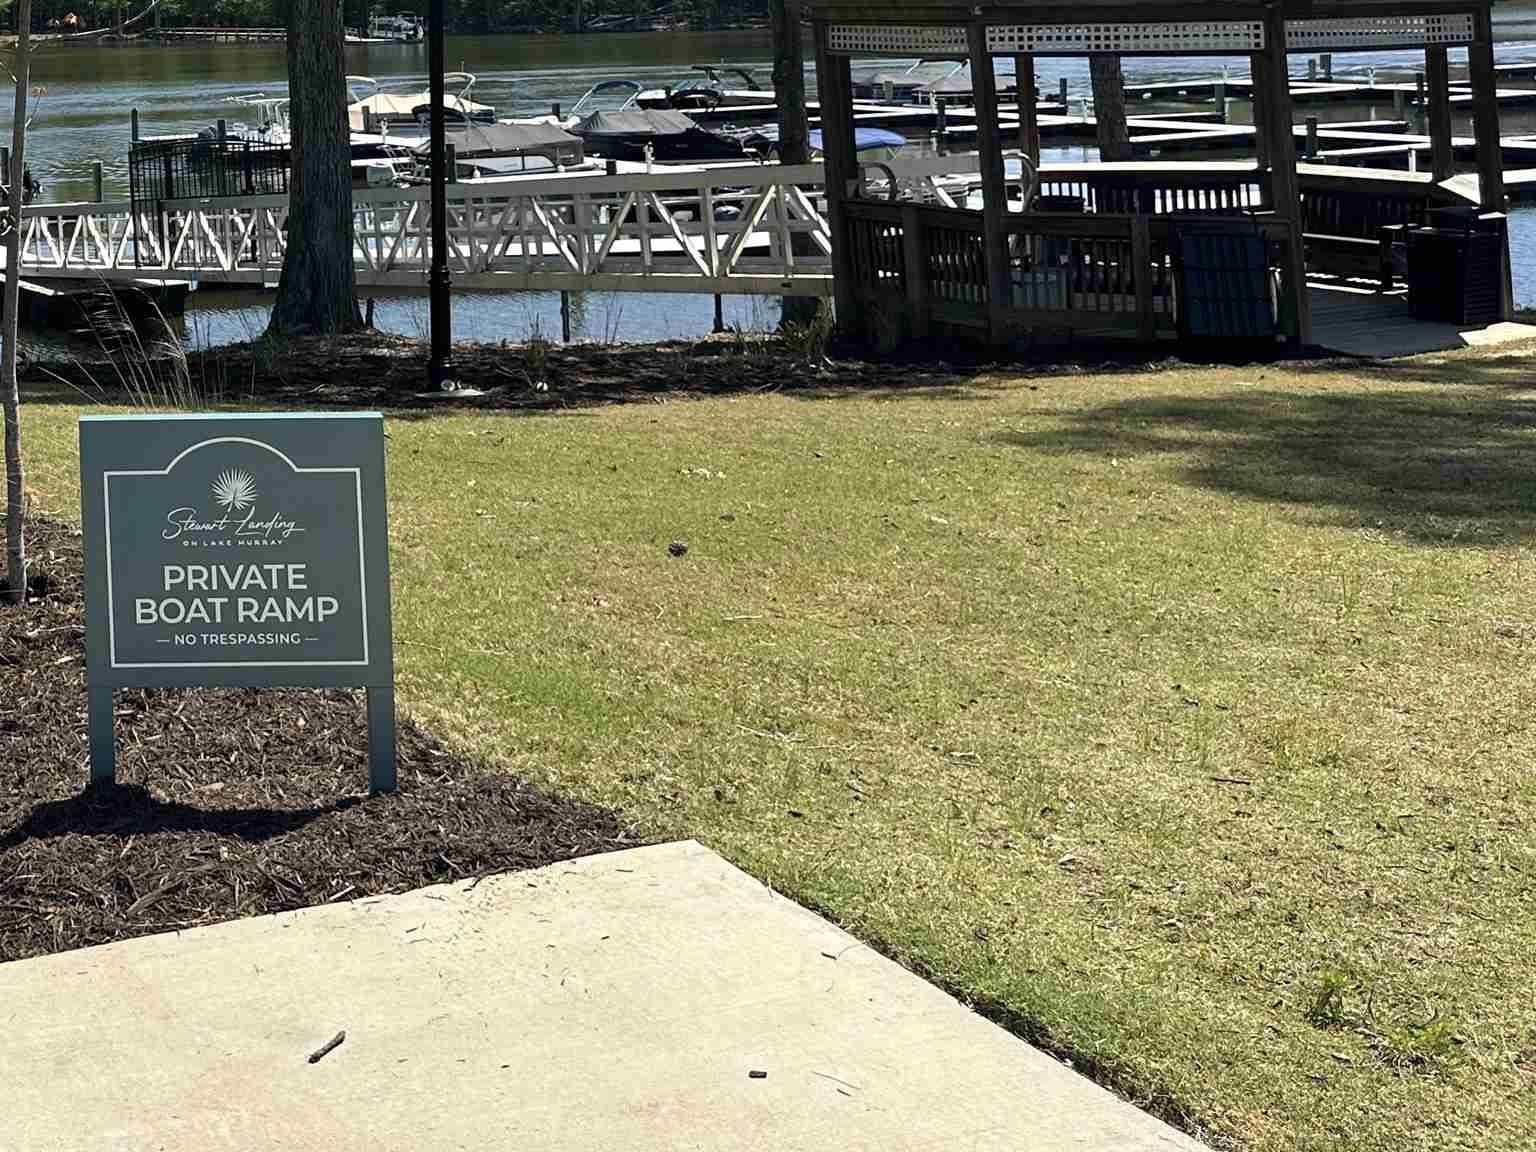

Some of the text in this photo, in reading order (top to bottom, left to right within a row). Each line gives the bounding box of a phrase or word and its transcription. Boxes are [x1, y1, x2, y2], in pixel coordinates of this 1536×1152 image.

[162, 506, 305, 539] Stewart Landing
[163, 563, 308, 591] PRIVATE
[135, 596, 339, 624] BOAT RAMP
[174, 632, 302, 645] NO TRESPASSING
